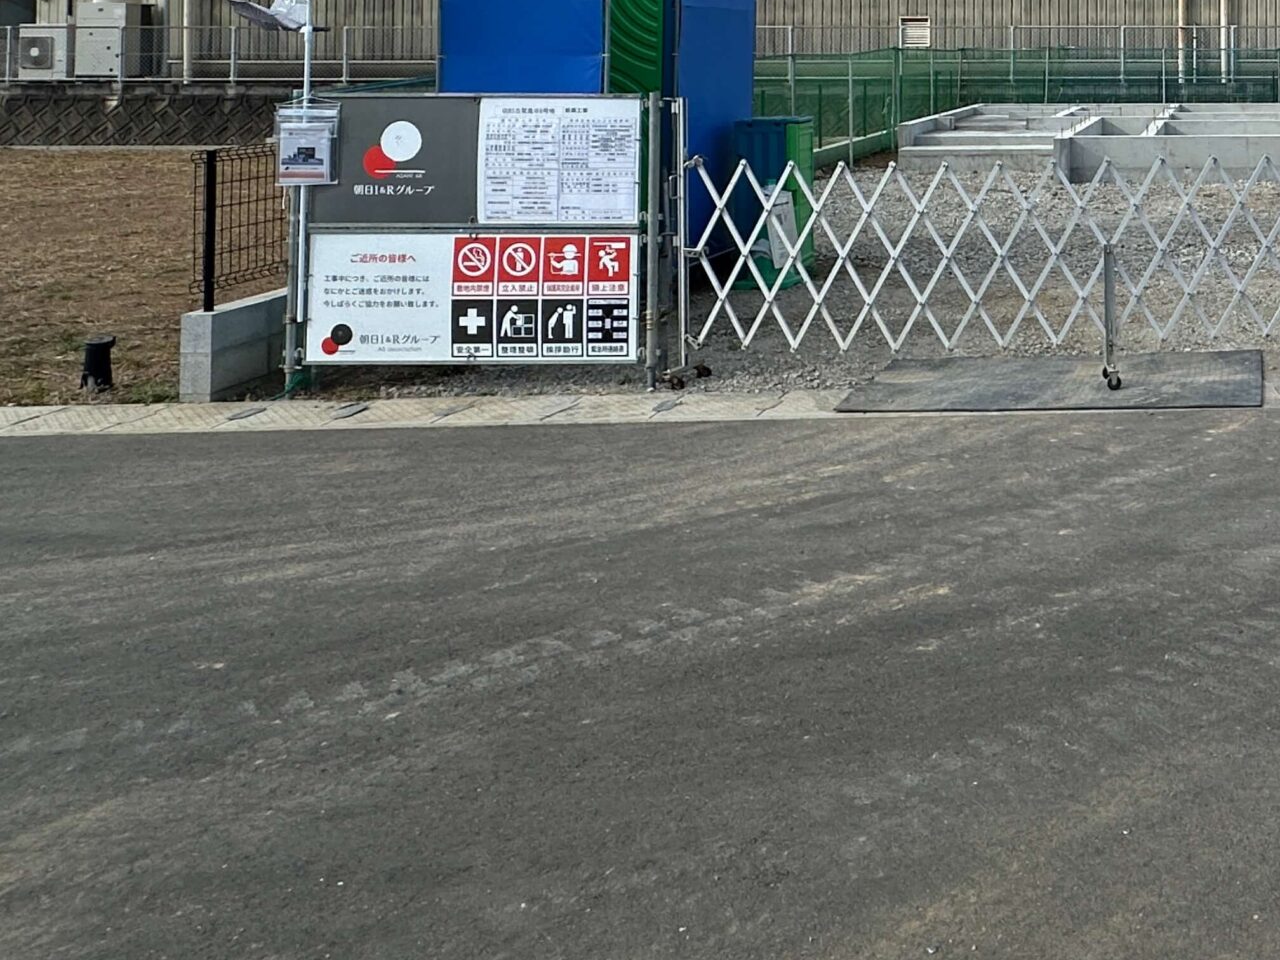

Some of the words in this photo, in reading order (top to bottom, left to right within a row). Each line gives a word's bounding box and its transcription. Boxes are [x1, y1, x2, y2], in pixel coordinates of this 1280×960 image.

[349, 253, 417, 264] ご近所の皆様へ
[501, 284, 535, 293] 立入禁止
[359, 334, 441, 345] 朝日I&Rグループ
[455, 345, 490, 354] 安全第一
